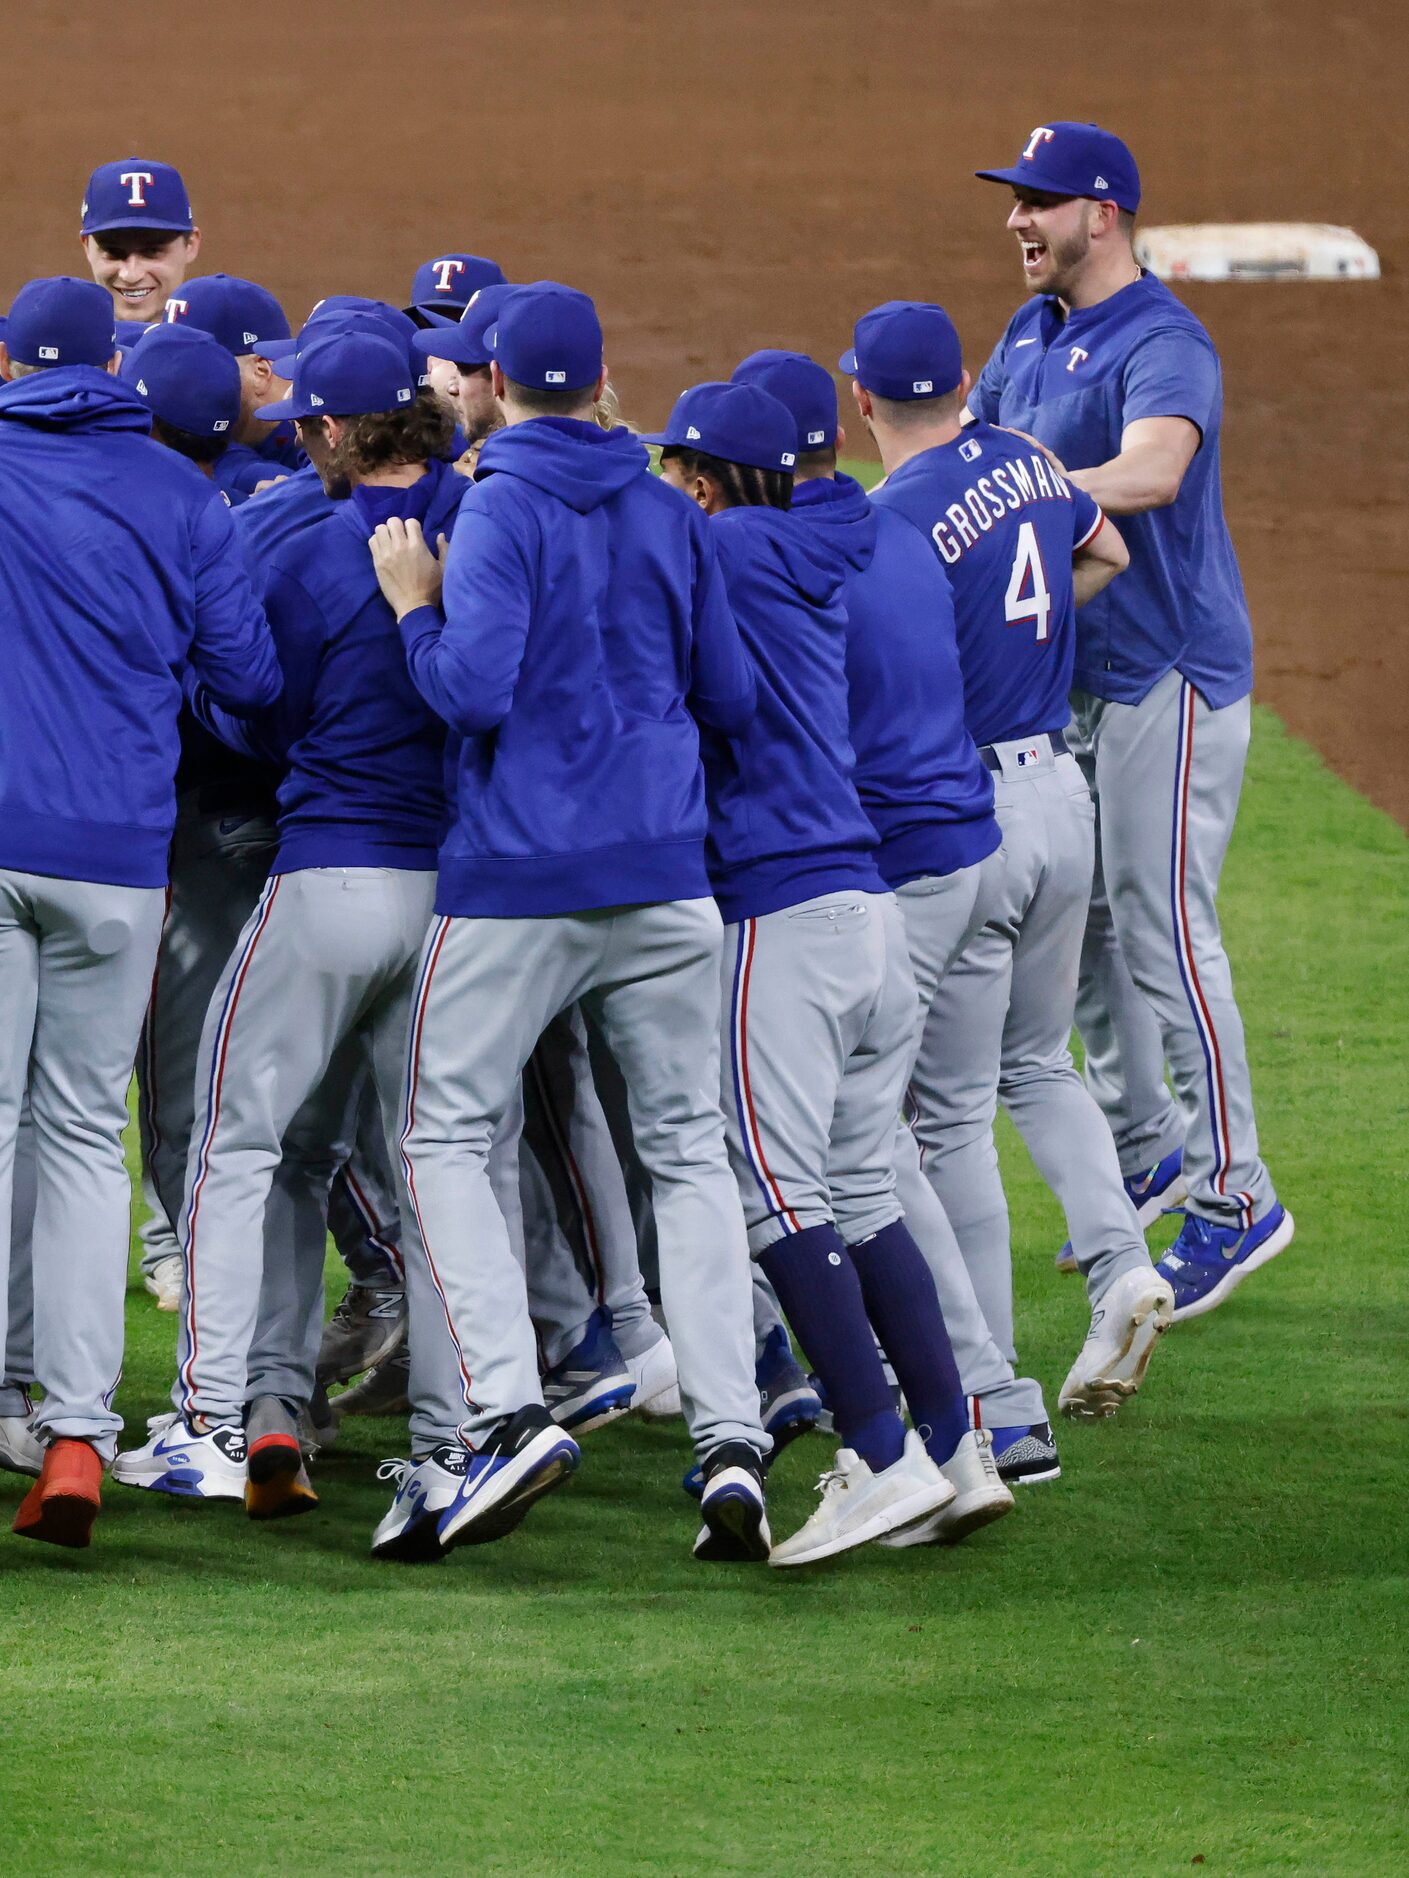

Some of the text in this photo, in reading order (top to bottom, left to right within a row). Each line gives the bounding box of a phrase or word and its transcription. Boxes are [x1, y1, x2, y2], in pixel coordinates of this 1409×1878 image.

[1022, 127, 1056, 161] T
[120, 172, 154, 208] T
[432, 260, 465, 292] T
[164, 299, 189, 323] T
[1066, 346, 1089, 374] T
[931, 455, 1073, 566] GROSSMAN
[1004, 521, 1052, 644] 4
